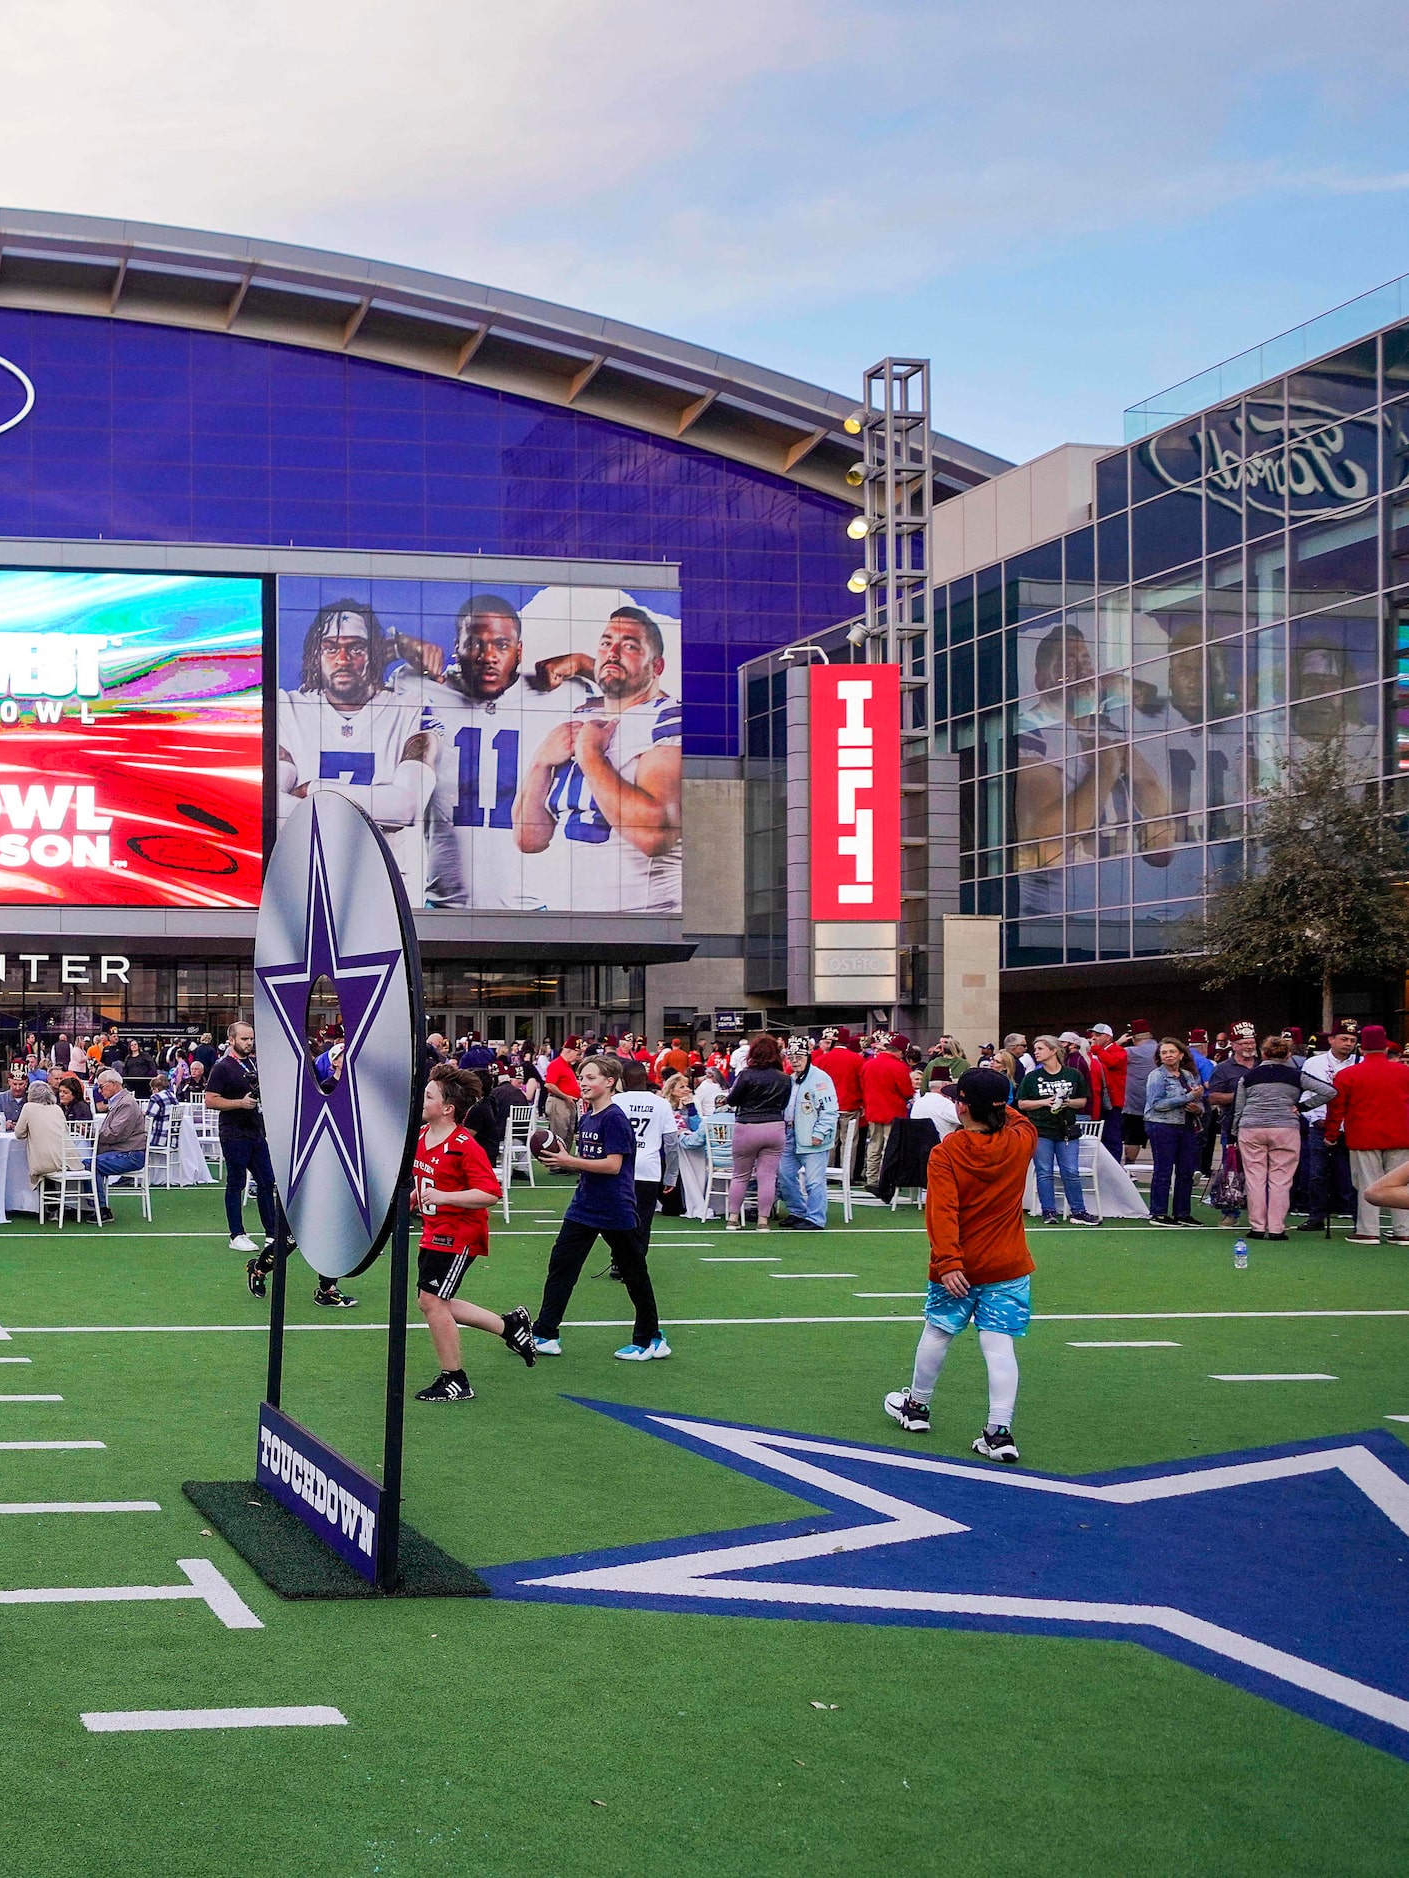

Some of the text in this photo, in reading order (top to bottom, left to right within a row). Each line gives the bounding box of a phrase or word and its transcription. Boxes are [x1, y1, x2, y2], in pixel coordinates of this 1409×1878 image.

[452, 726, 520, 830] 11
[629, 1104, 654, 1113] TAYLOR
[455, 1133, 469, 1144] 16
[260, 1424, 376, 1558] TOUCHDOWN
